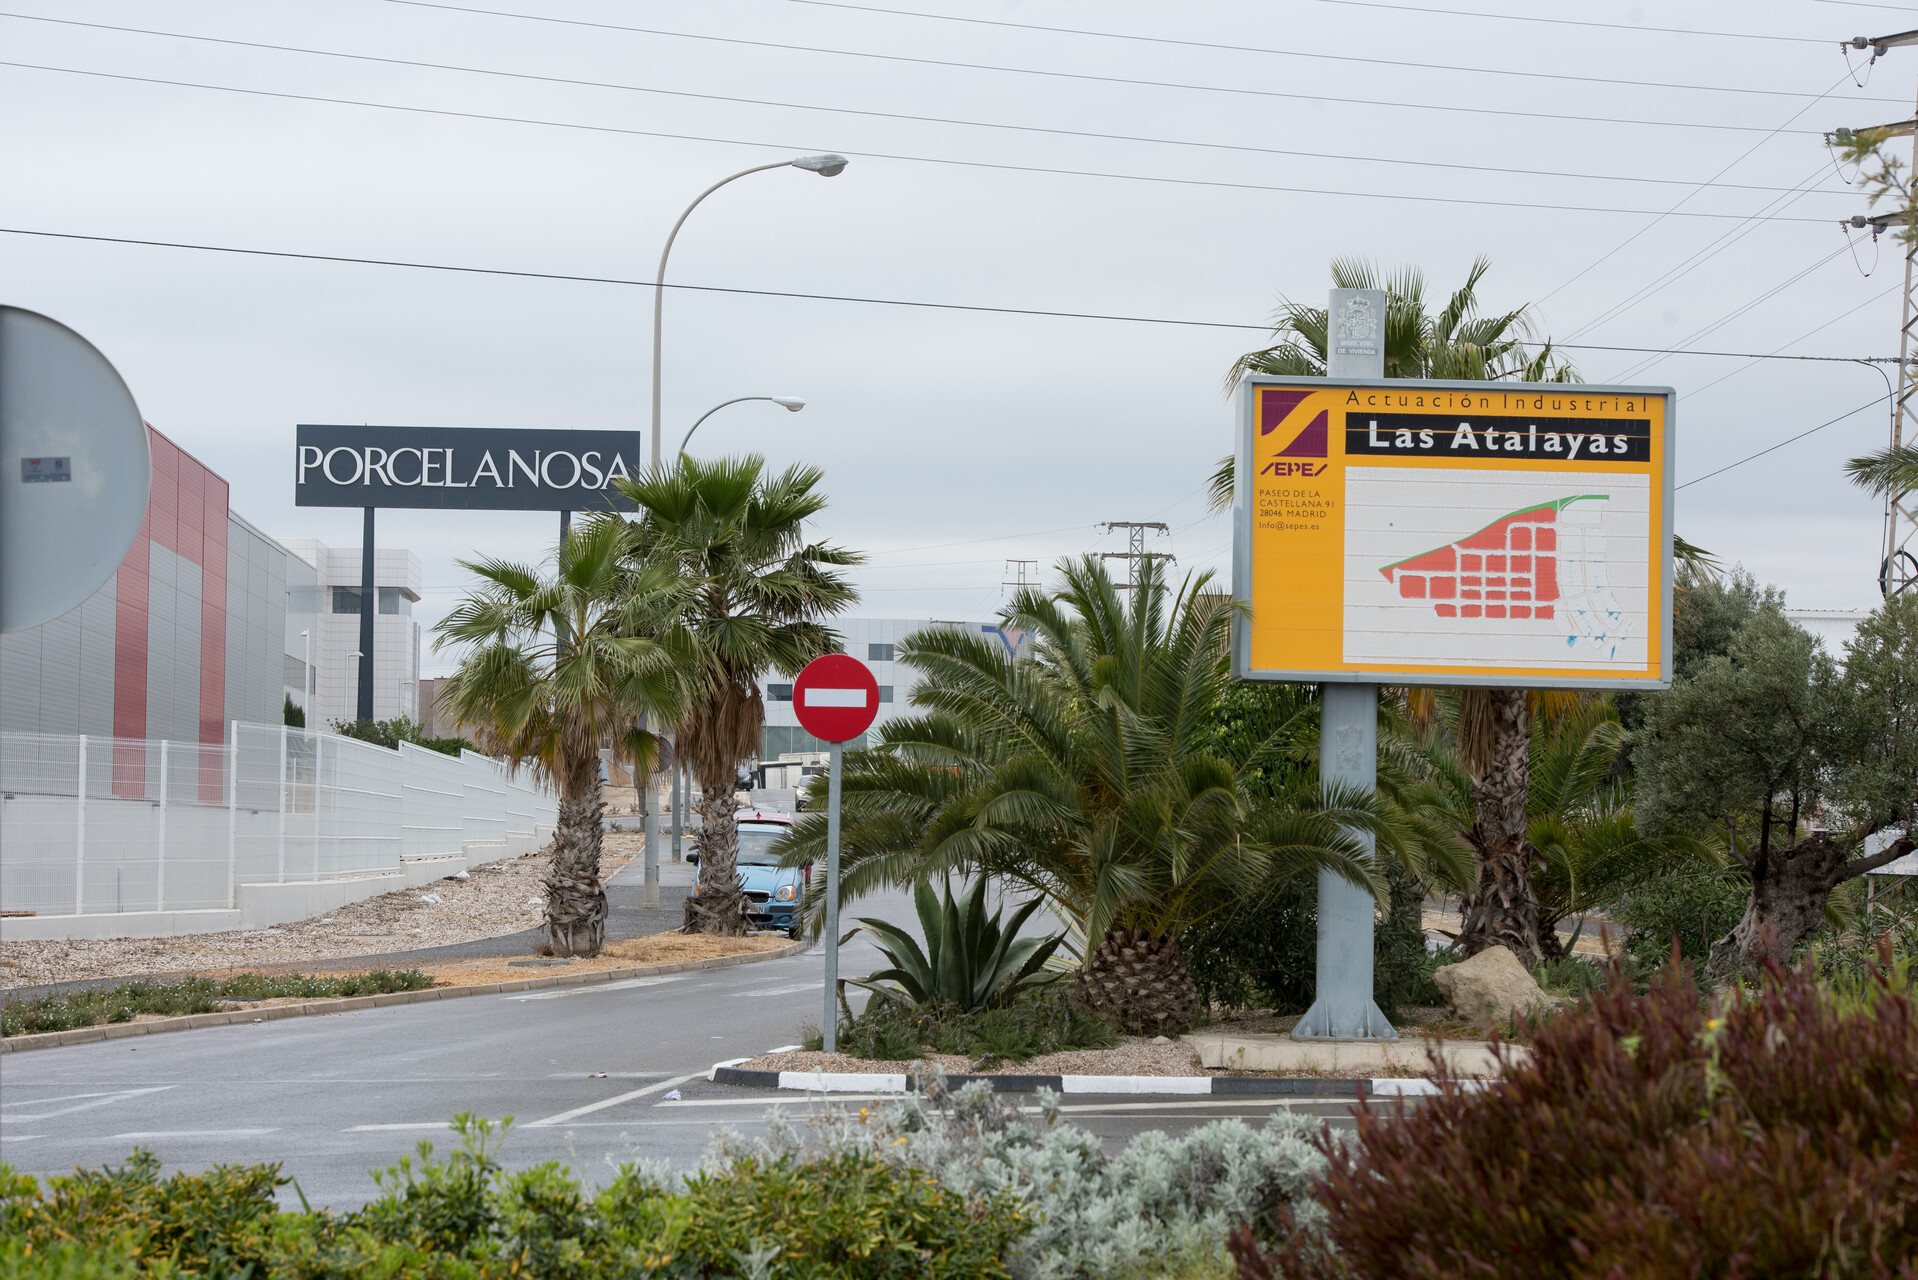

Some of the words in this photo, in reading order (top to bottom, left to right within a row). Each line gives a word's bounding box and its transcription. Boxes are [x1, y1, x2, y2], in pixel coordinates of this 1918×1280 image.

[1346, 390, 1489, 408] Actuación
[1503, 394, 1647, 413] Industrial
[1369, 420, 1435, 449] Las
[1450, 422, 1629, 460] Atalayas
[298, 446, 633, 490] PORCELANOSA
[1260, 462, 1328, 477] SEPES
[1259, 489, 1290, 498] PASEO
[1293, 490, 1306, 498] DE
[1308, 490, 1321, 498] LA
[1259, 499, 1322, 508] CASTELLANA
[1325, 500, 1335, 508] 91
[1260, 509, 1283, 517] 28046
[1286, 510, 1327, 518] MADRID
[1259, 521, 1320, 531] Info@sepes.es
